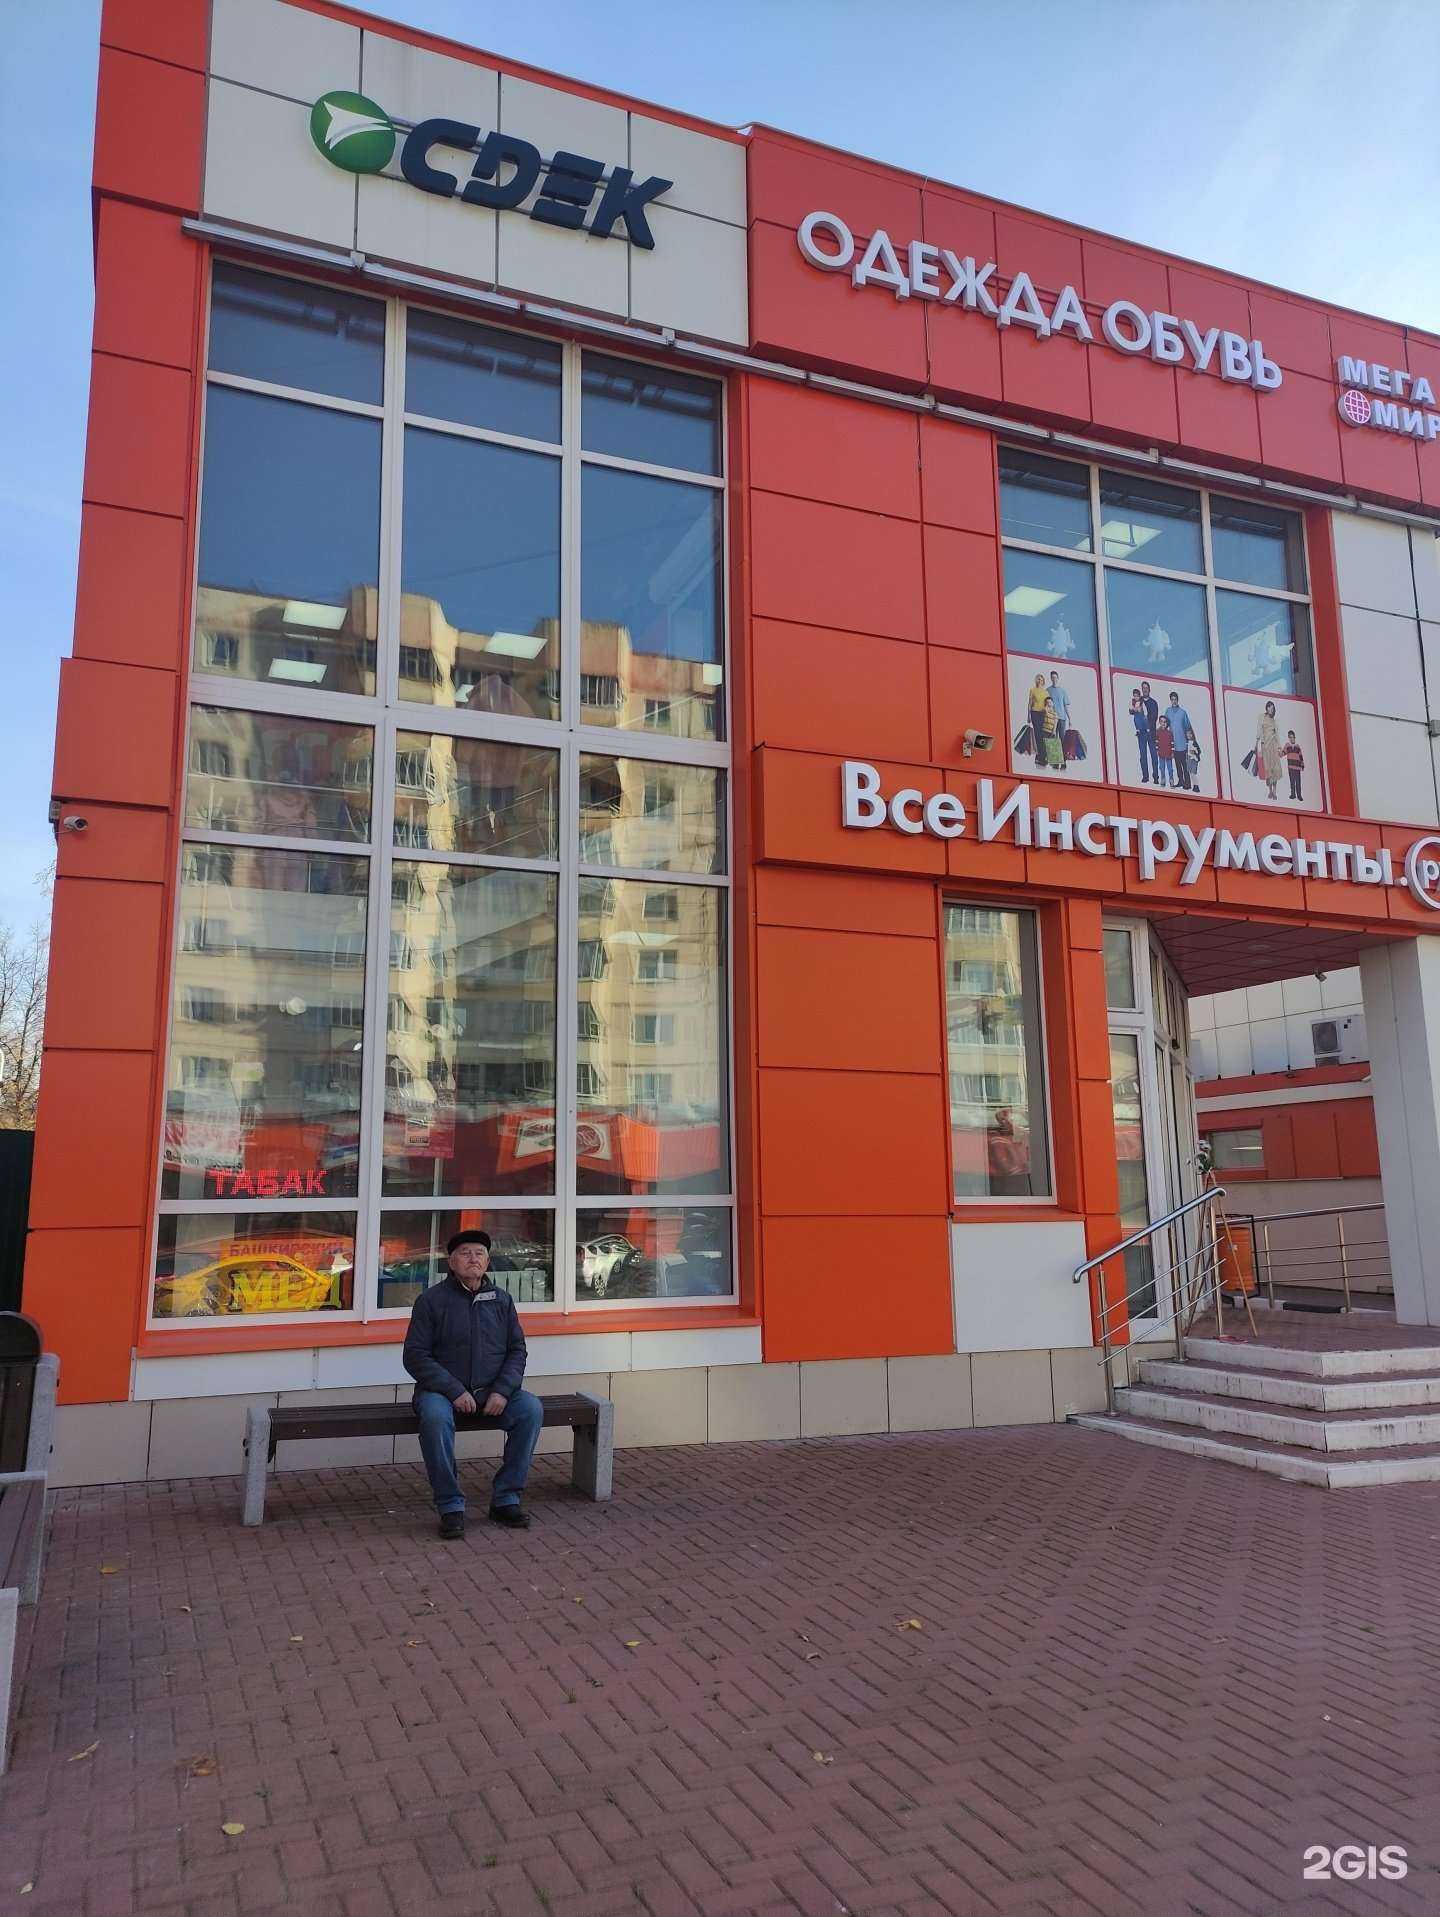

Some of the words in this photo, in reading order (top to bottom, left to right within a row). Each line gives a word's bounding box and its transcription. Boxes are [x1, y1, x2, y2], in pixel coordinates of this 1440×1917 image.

[401, 118, 674, 250] CDEK
[797, 211, 1093, 343] ОДЕЖДА
[1102, 301, 1283, 393] ОБУВЬ
[1338, 355, 1436, 406] МЕГА
[1371, 399, 1440, 442] МИР
[205, 1167, 328, 1196] ТАБАК
